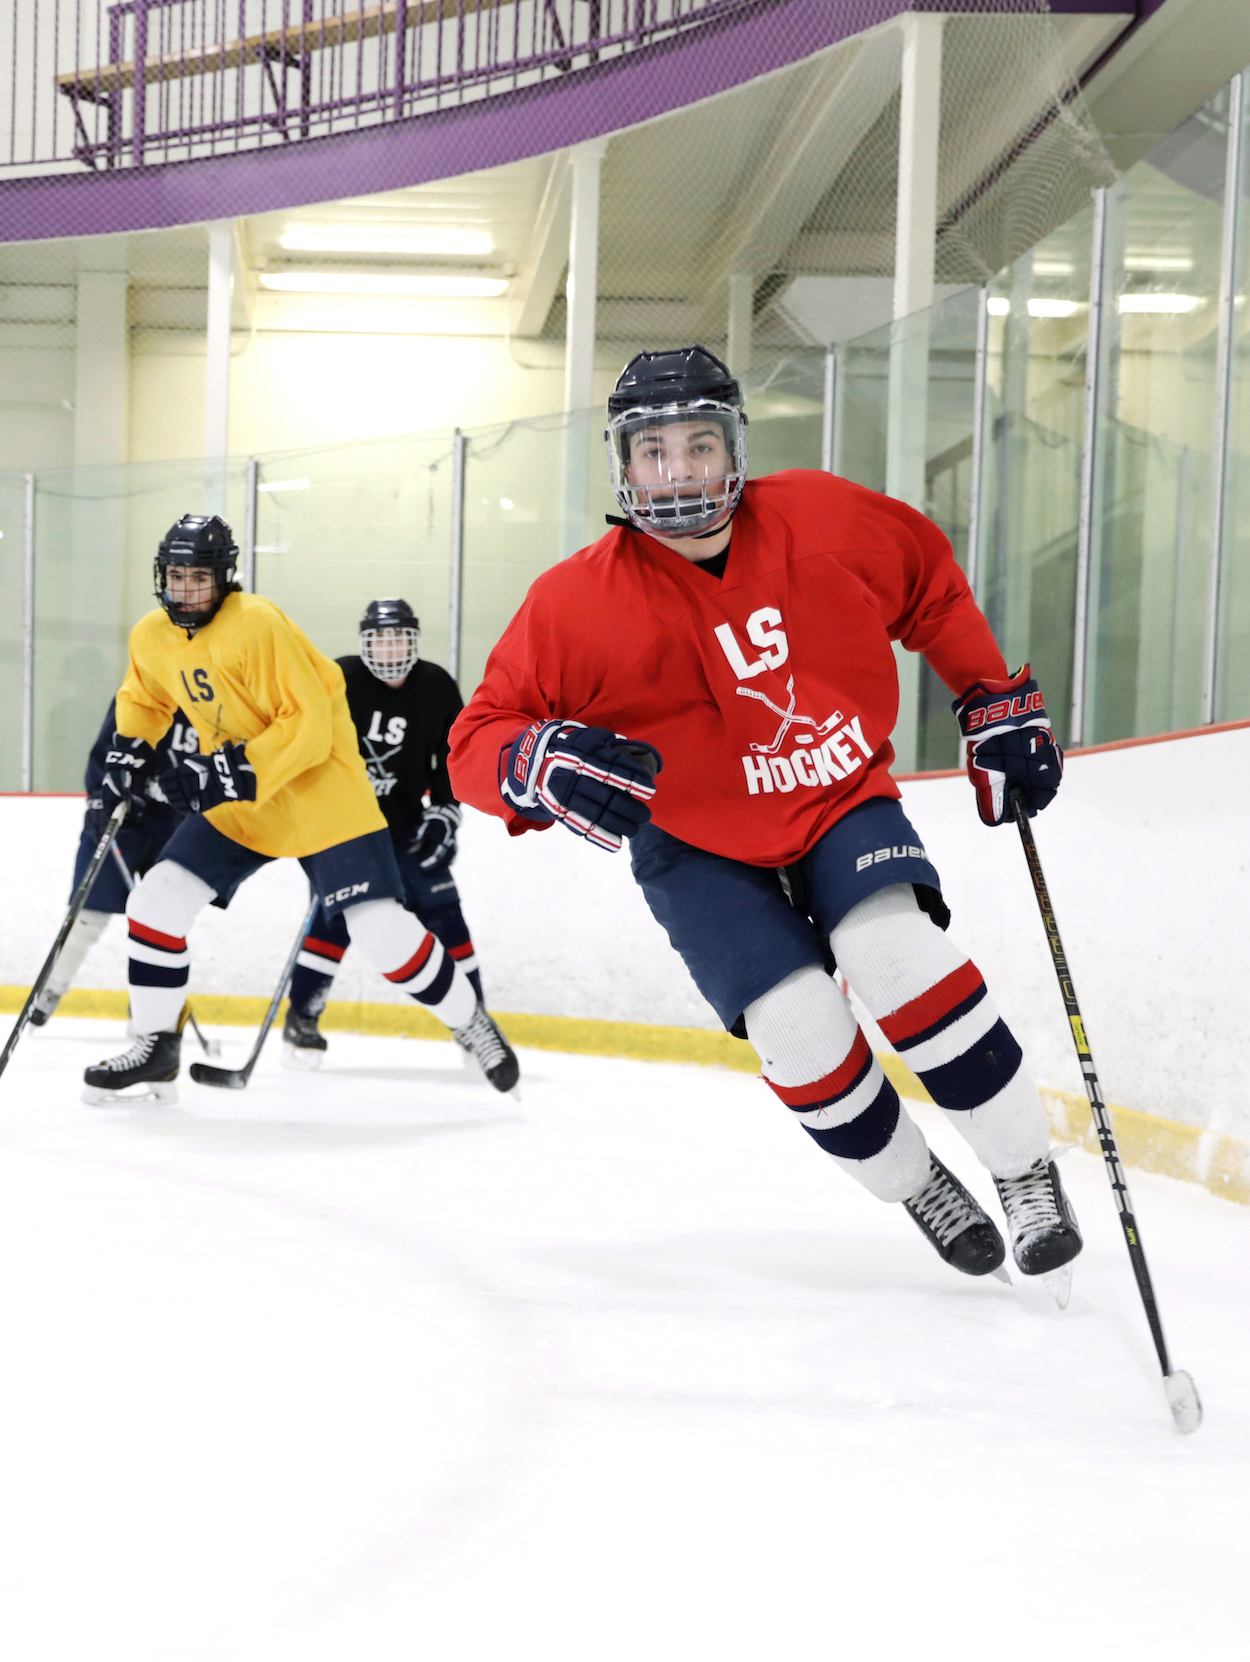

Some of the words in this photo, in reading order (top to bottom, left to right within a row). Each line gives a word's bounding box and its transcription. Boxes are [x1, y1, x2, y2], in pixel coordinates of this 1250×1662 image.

[713, 606, 789, 680] LS
[180, 668, 215, 702] LS
[171, 723, 199, 754] LS
[367, 710, 407, 746] LS
[741, 715, 874, 796] HOCKEY
[324, 881, 370, 908] CCM
